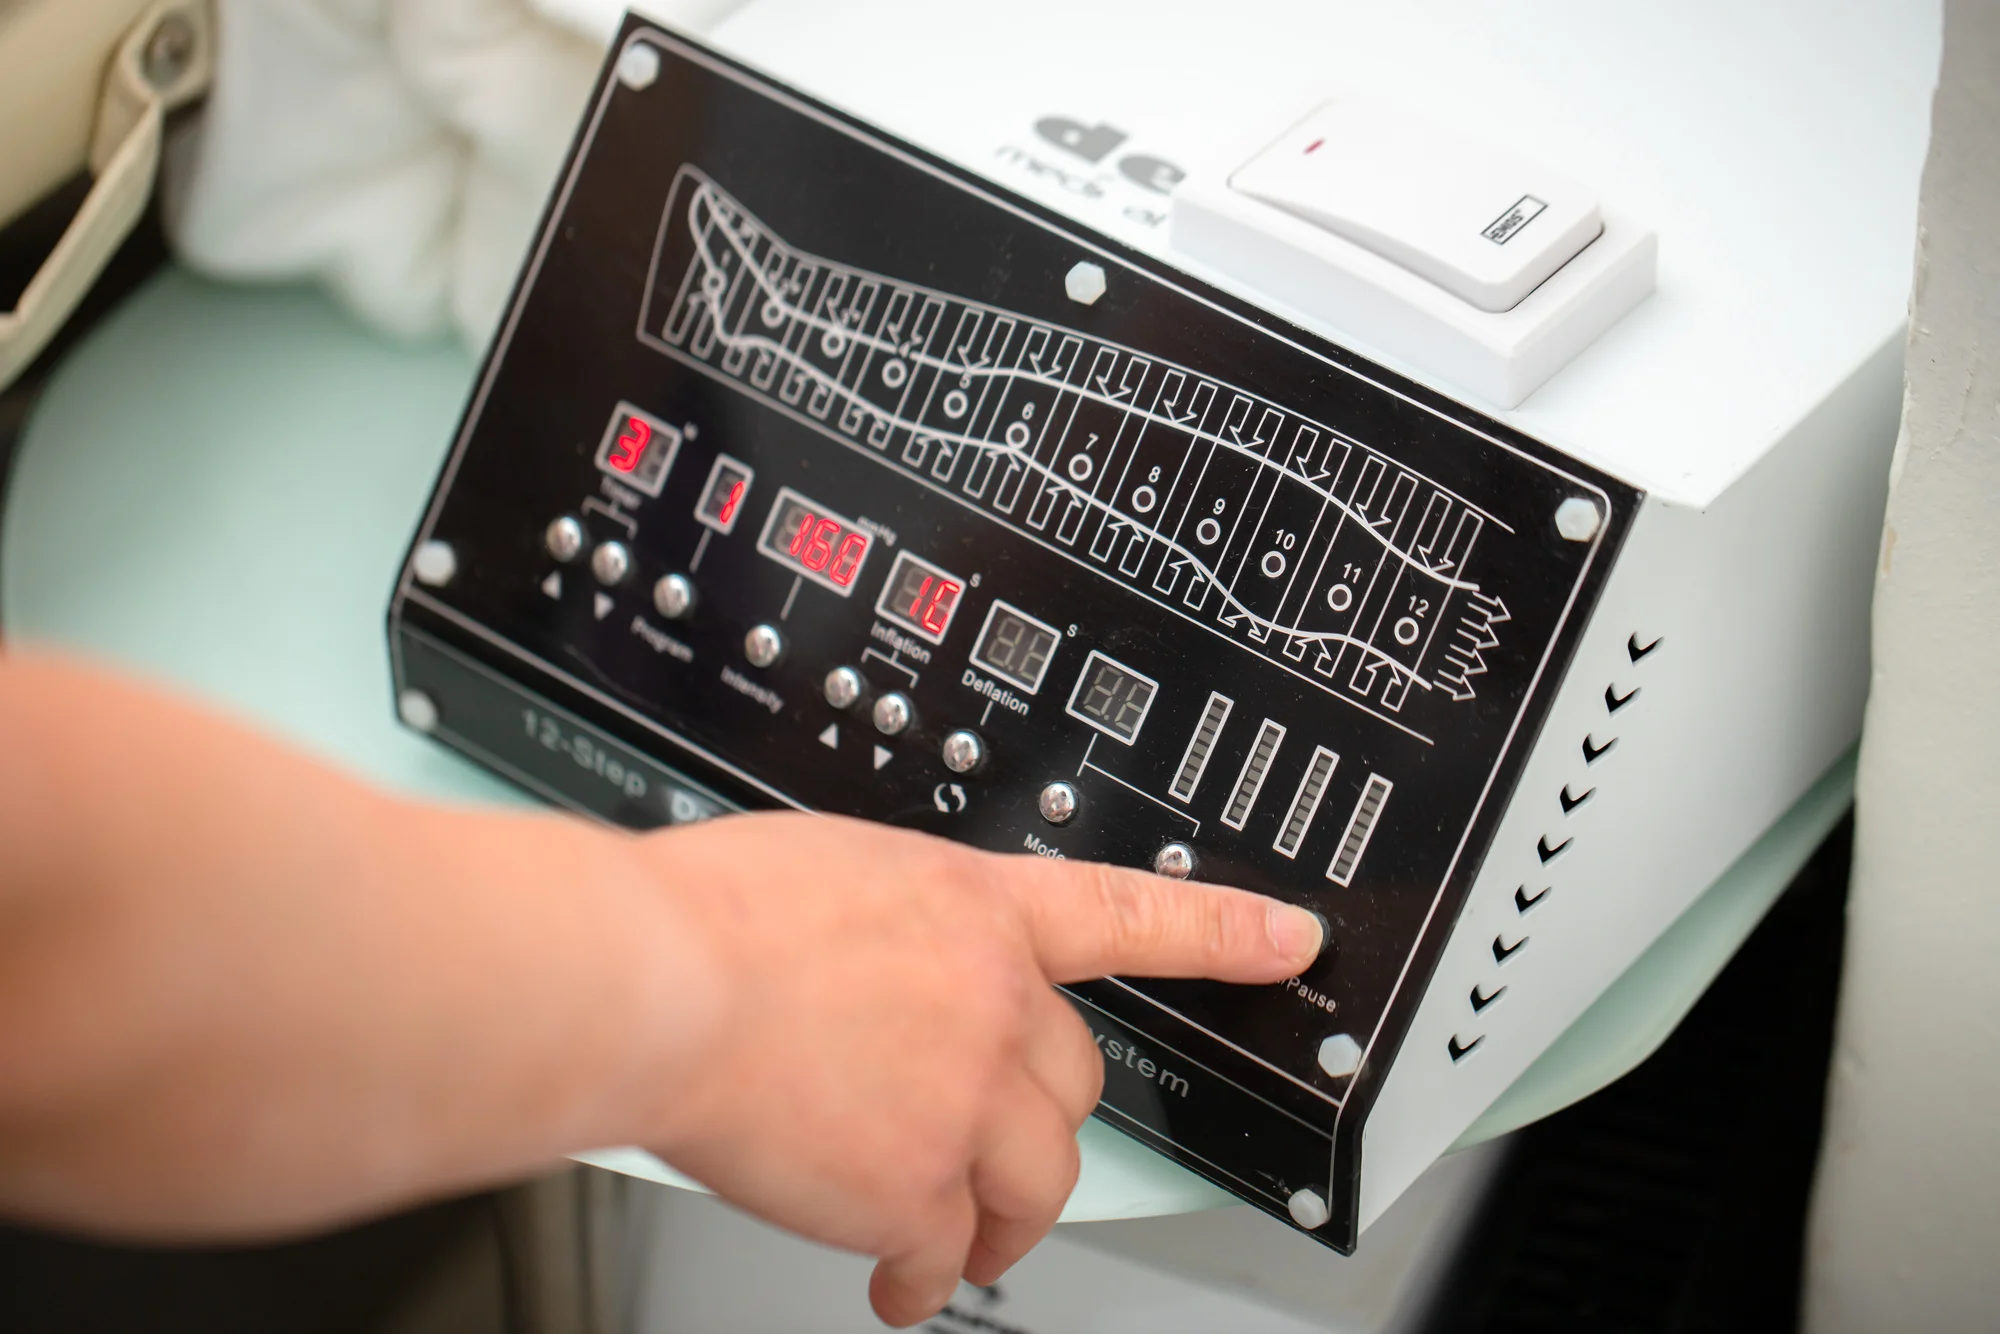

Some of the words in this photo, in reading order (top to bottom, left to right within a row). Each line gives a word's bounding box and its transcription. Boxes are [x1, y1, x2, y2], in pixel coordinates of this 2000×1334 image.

[1022, 402, 1036, 421] 6
[609, 416, 651, 474] 3
[1088, 433, 1099, 452] 7
[1148, 466, 1162, 484] 8
[719, 481, 745, 525] 1
[1212, 498, 1226, 516] 9
[789, 514, 867, 586] 160
[1275, 529, 1296, 551] 10
[1342, 563, 1362, 585] 11
[1407, 595, 1430, 618] 12
[870, 620, 932, 665] Inflation
[961, 669, 1030, 716] Deflation
[522, 708, 647, 799] 12-Step
